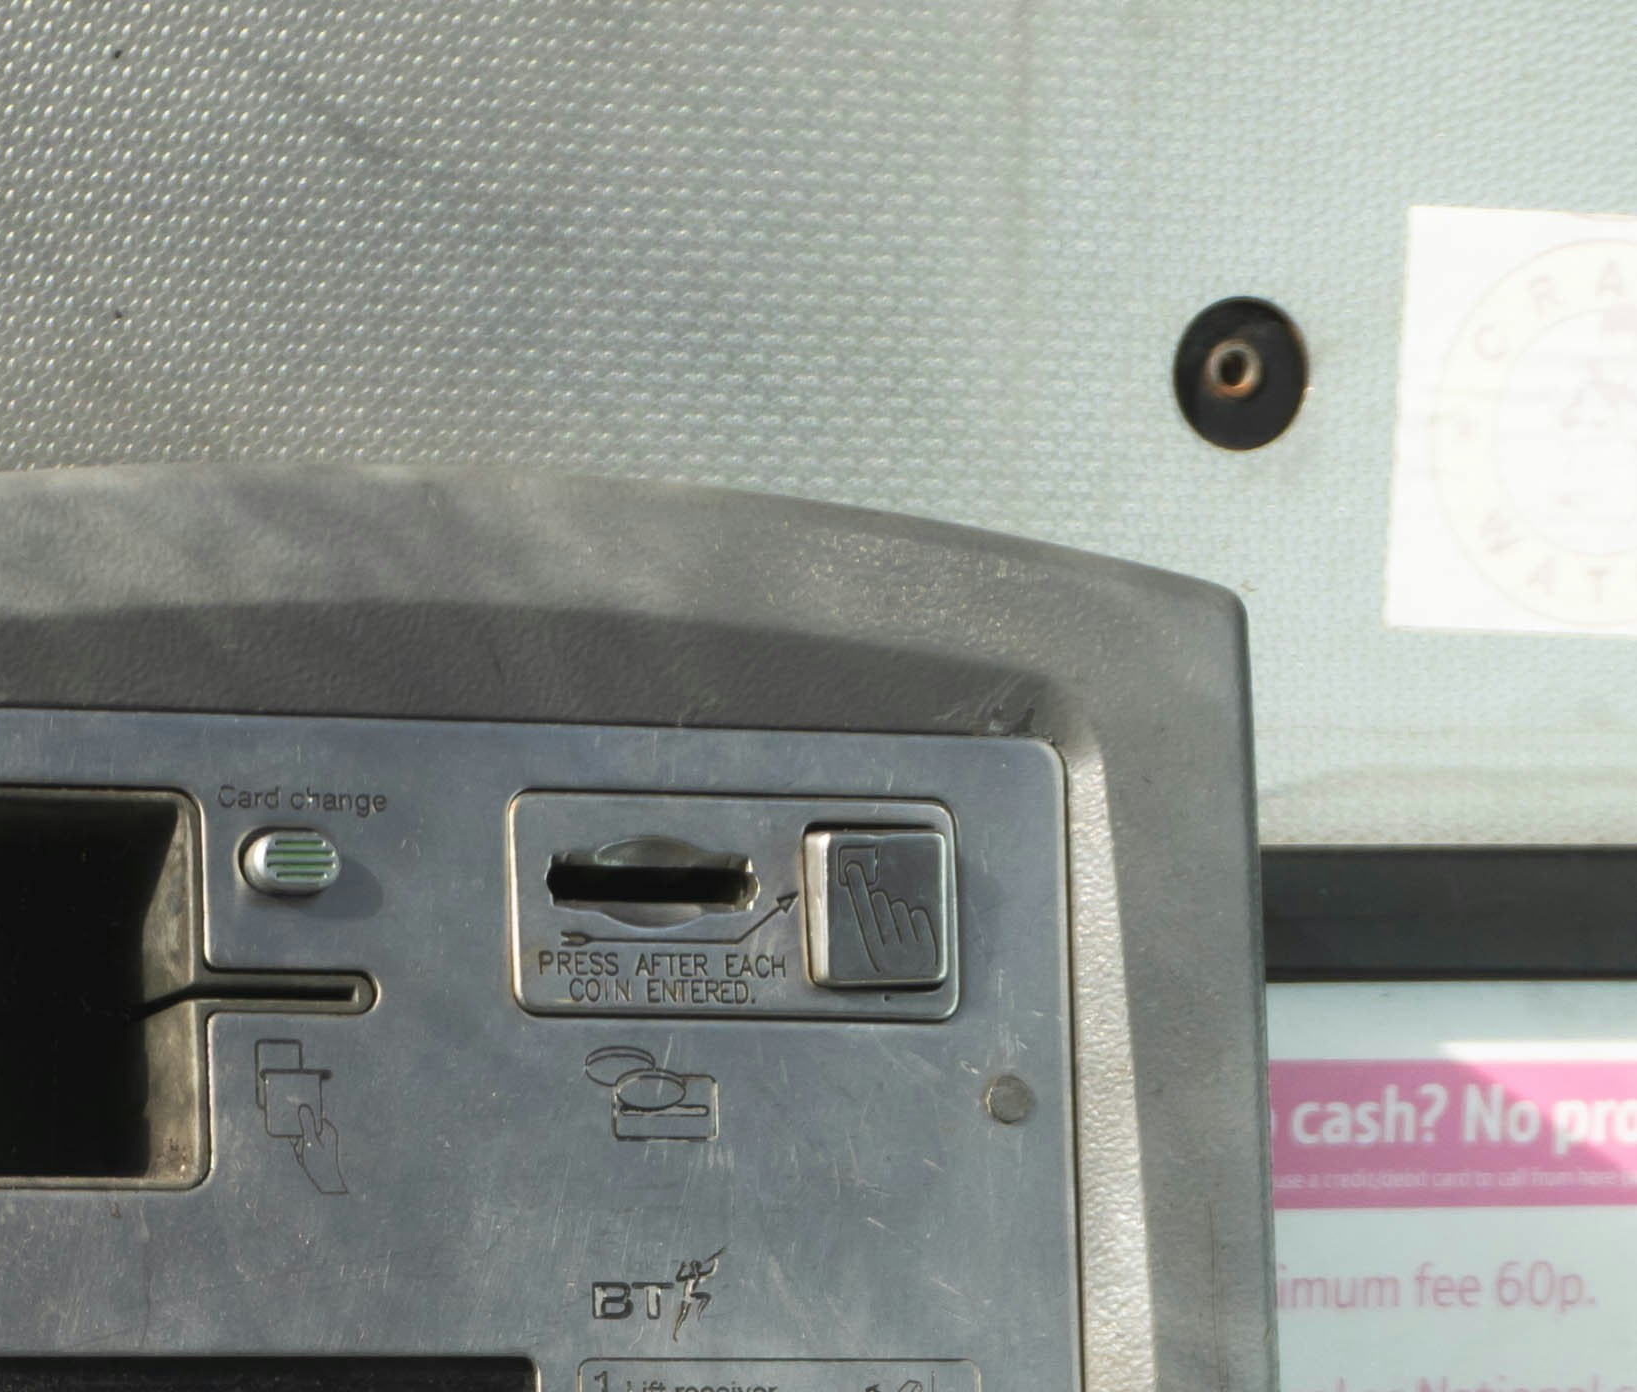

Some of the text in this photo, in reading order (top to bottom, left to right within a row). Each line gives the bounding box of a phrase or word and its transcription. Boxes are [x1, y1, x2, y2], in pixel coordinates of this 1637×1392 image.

[218, 785, 387, 819] Card change
[539, 952, 787, 978] PRESS AFTER EACH
[569, 980, 757, 1005] COIN ENTERED.
[1291, 1083, 1449, 1145] cash?
[1463, 1085, 1540, 1143] No
[1553, 1098, 1637, 1155] pro
[591, 1281, 672, 1320] BT
[1278, 1260, 1596, 1315] imum fee 60p.
